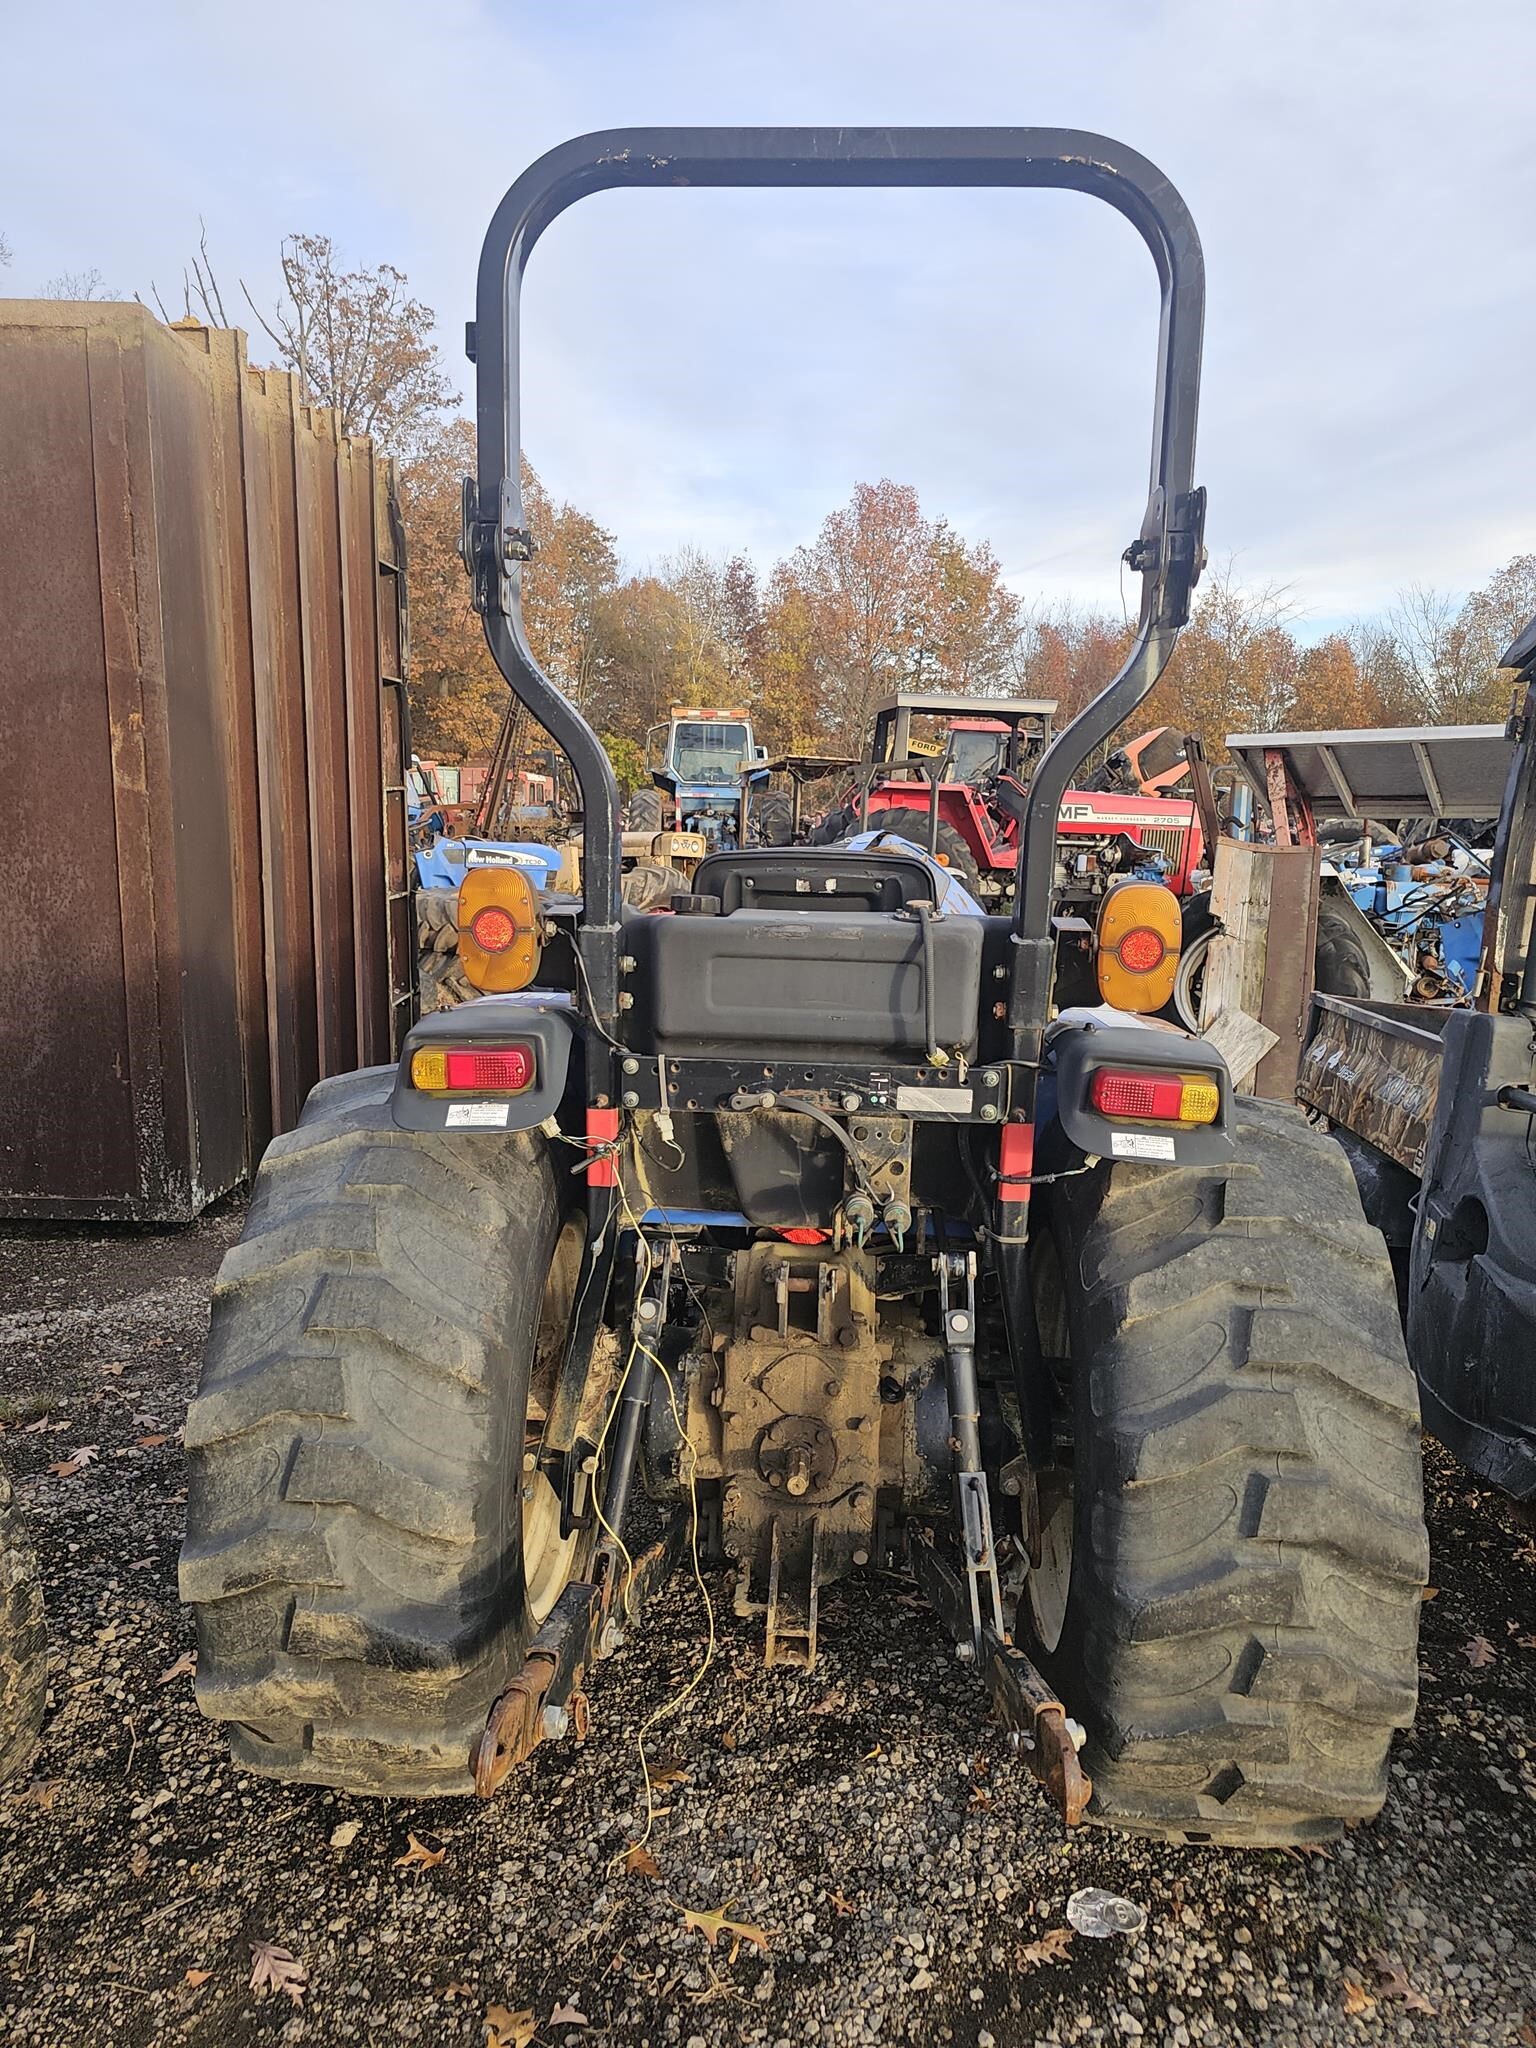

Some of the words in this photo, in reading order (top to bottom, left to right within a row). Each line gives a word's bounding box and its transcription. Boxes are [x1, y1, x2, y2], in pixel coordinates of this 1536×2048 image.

[911, 741, 936, 752] FORD
[1059, 806, 1088, 819] MF
[486, 855, 513, 865] Holland
